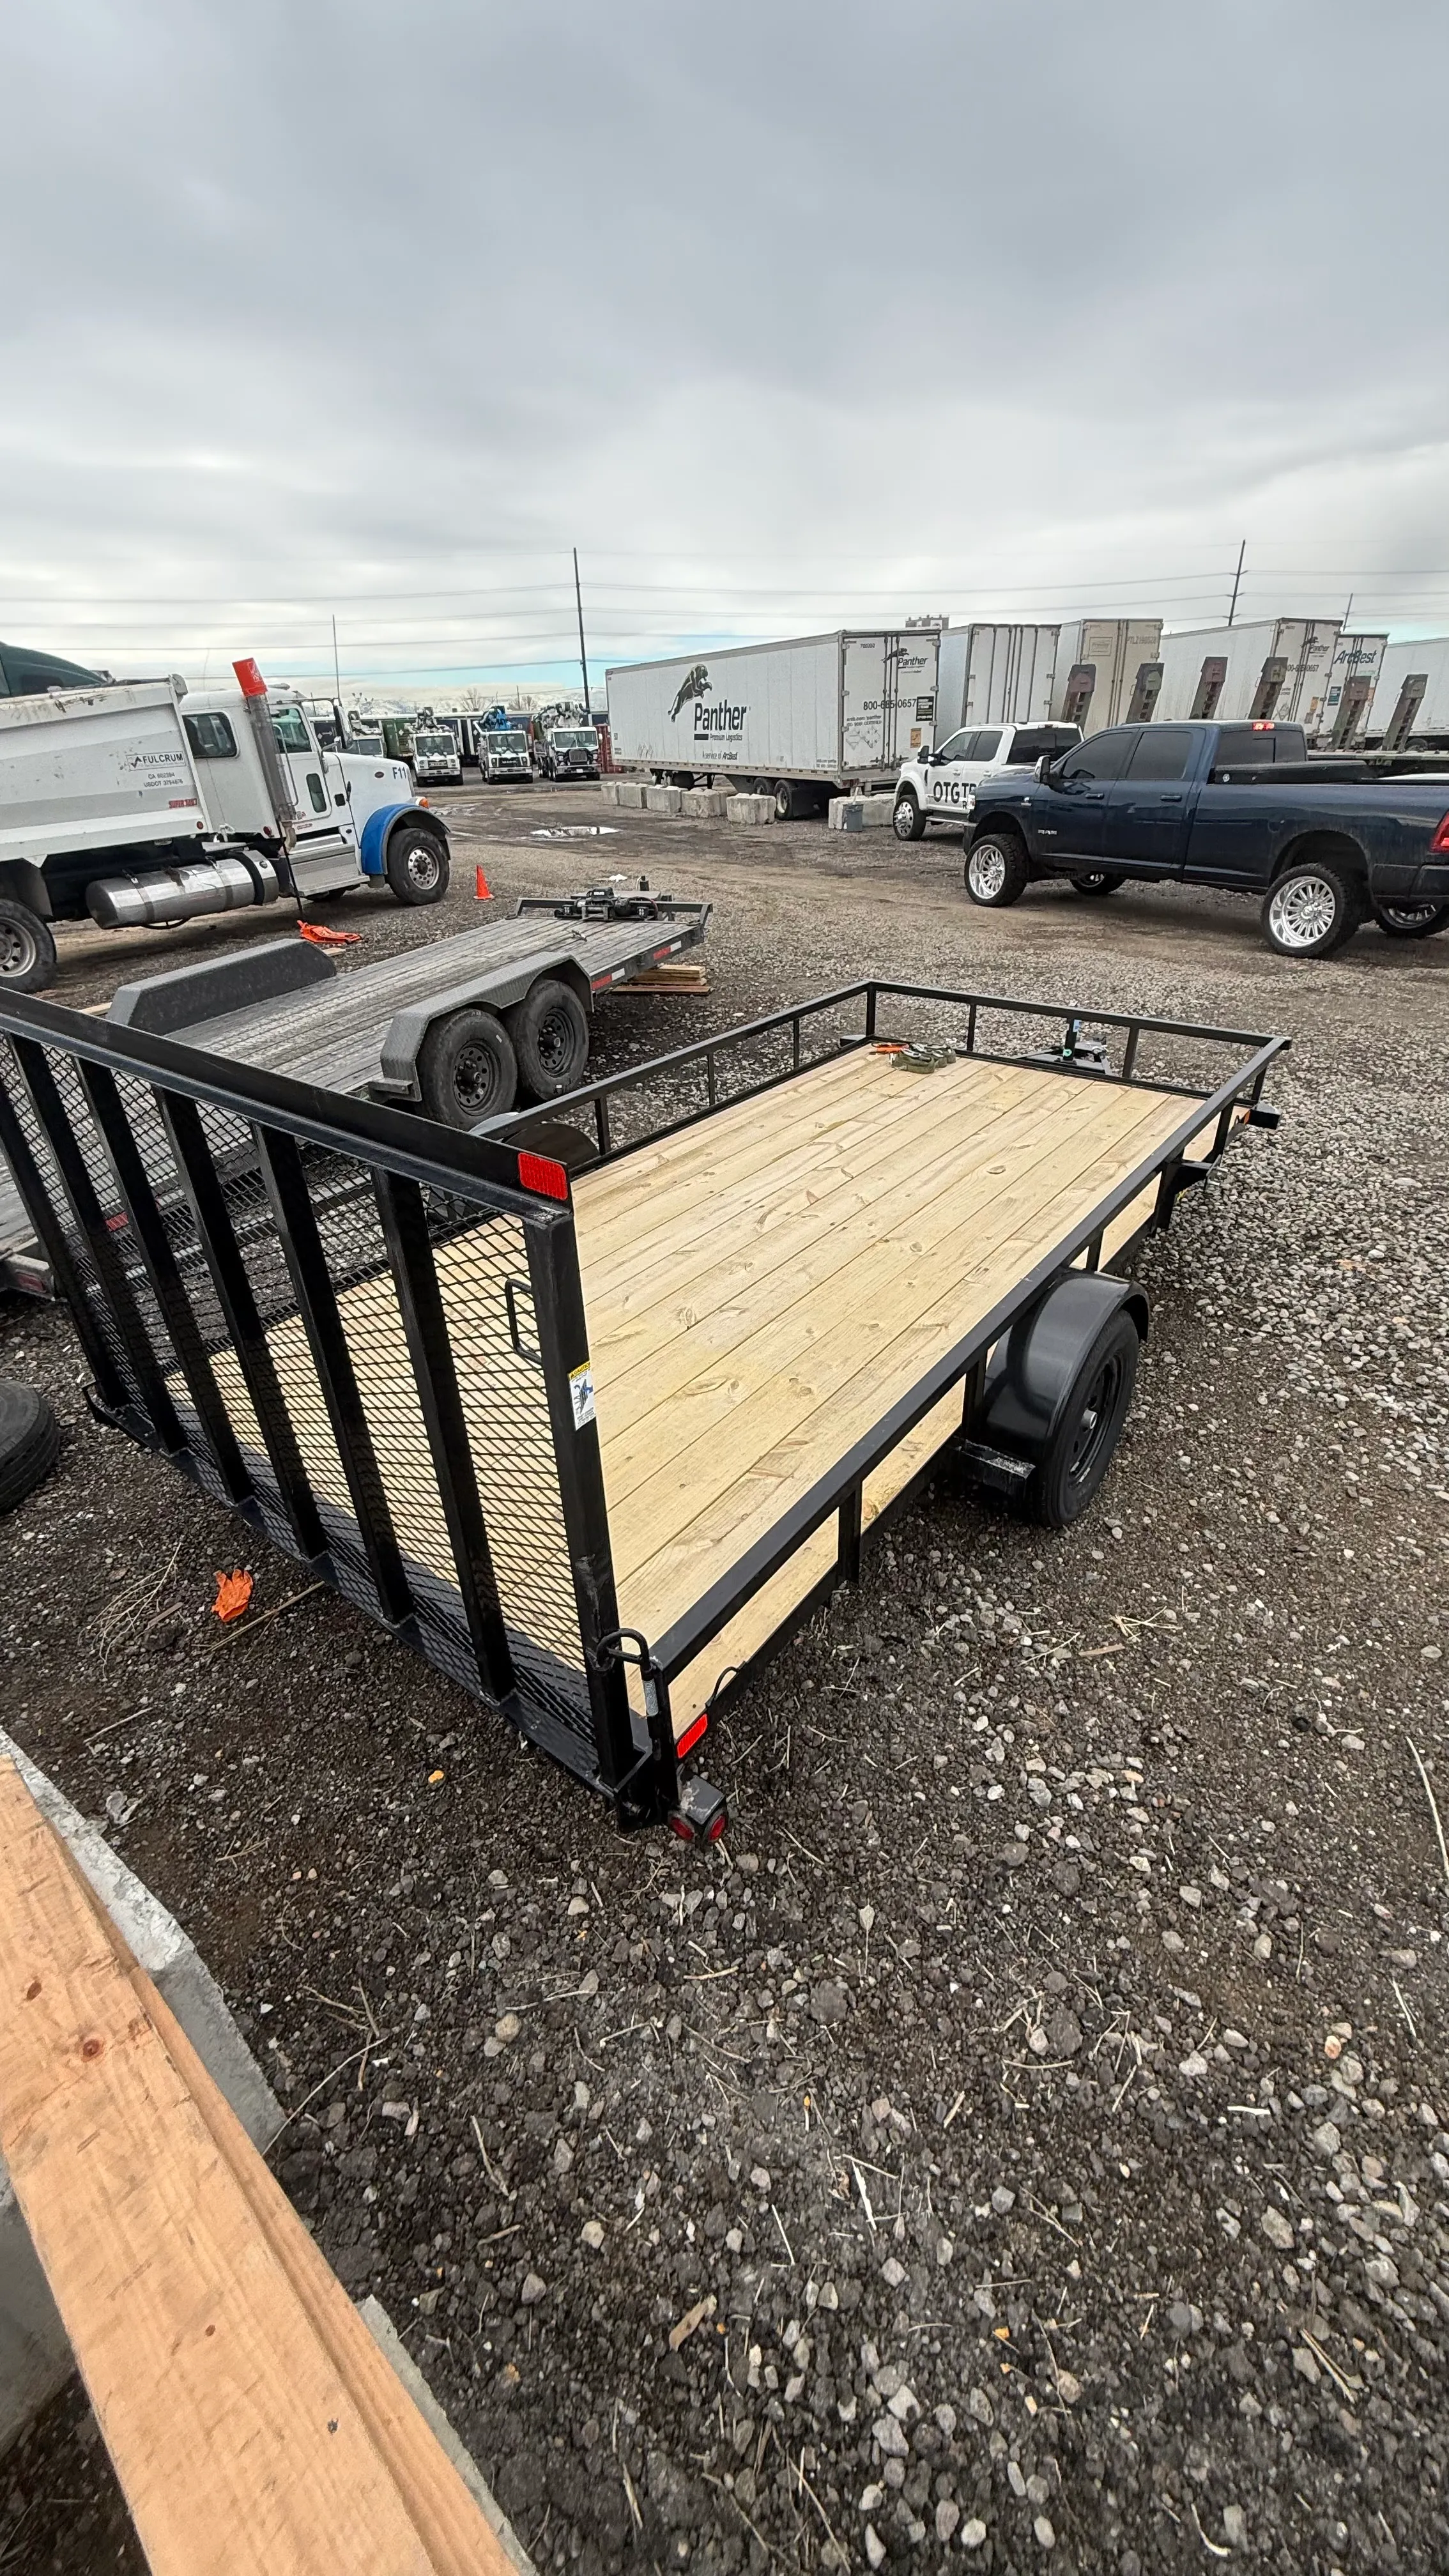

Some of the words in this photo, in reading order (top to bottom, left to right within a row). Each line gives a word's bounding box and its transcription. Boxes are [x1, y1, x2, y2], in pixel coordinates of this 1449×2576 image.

[898, 656, 928, 666] Panther
[1333, 650, 1377, 664] ArcBest
[1287, 664, 1319, 672] 00-685-0657
[863, 698, 917, 711] 800-685-0657
[694, 699, 747, 732] Panther
[726, 733, 742, 742] Logistics
[142, 753, 183, 764] FULCRUM
[705, 751, 717, 760] service
[718, 750, 722, 759] of
[722, 751, 739, 760] ArcBest
[392, 767, 407, 779] F11
[574, 1361, 591, 1375] CAUTION
